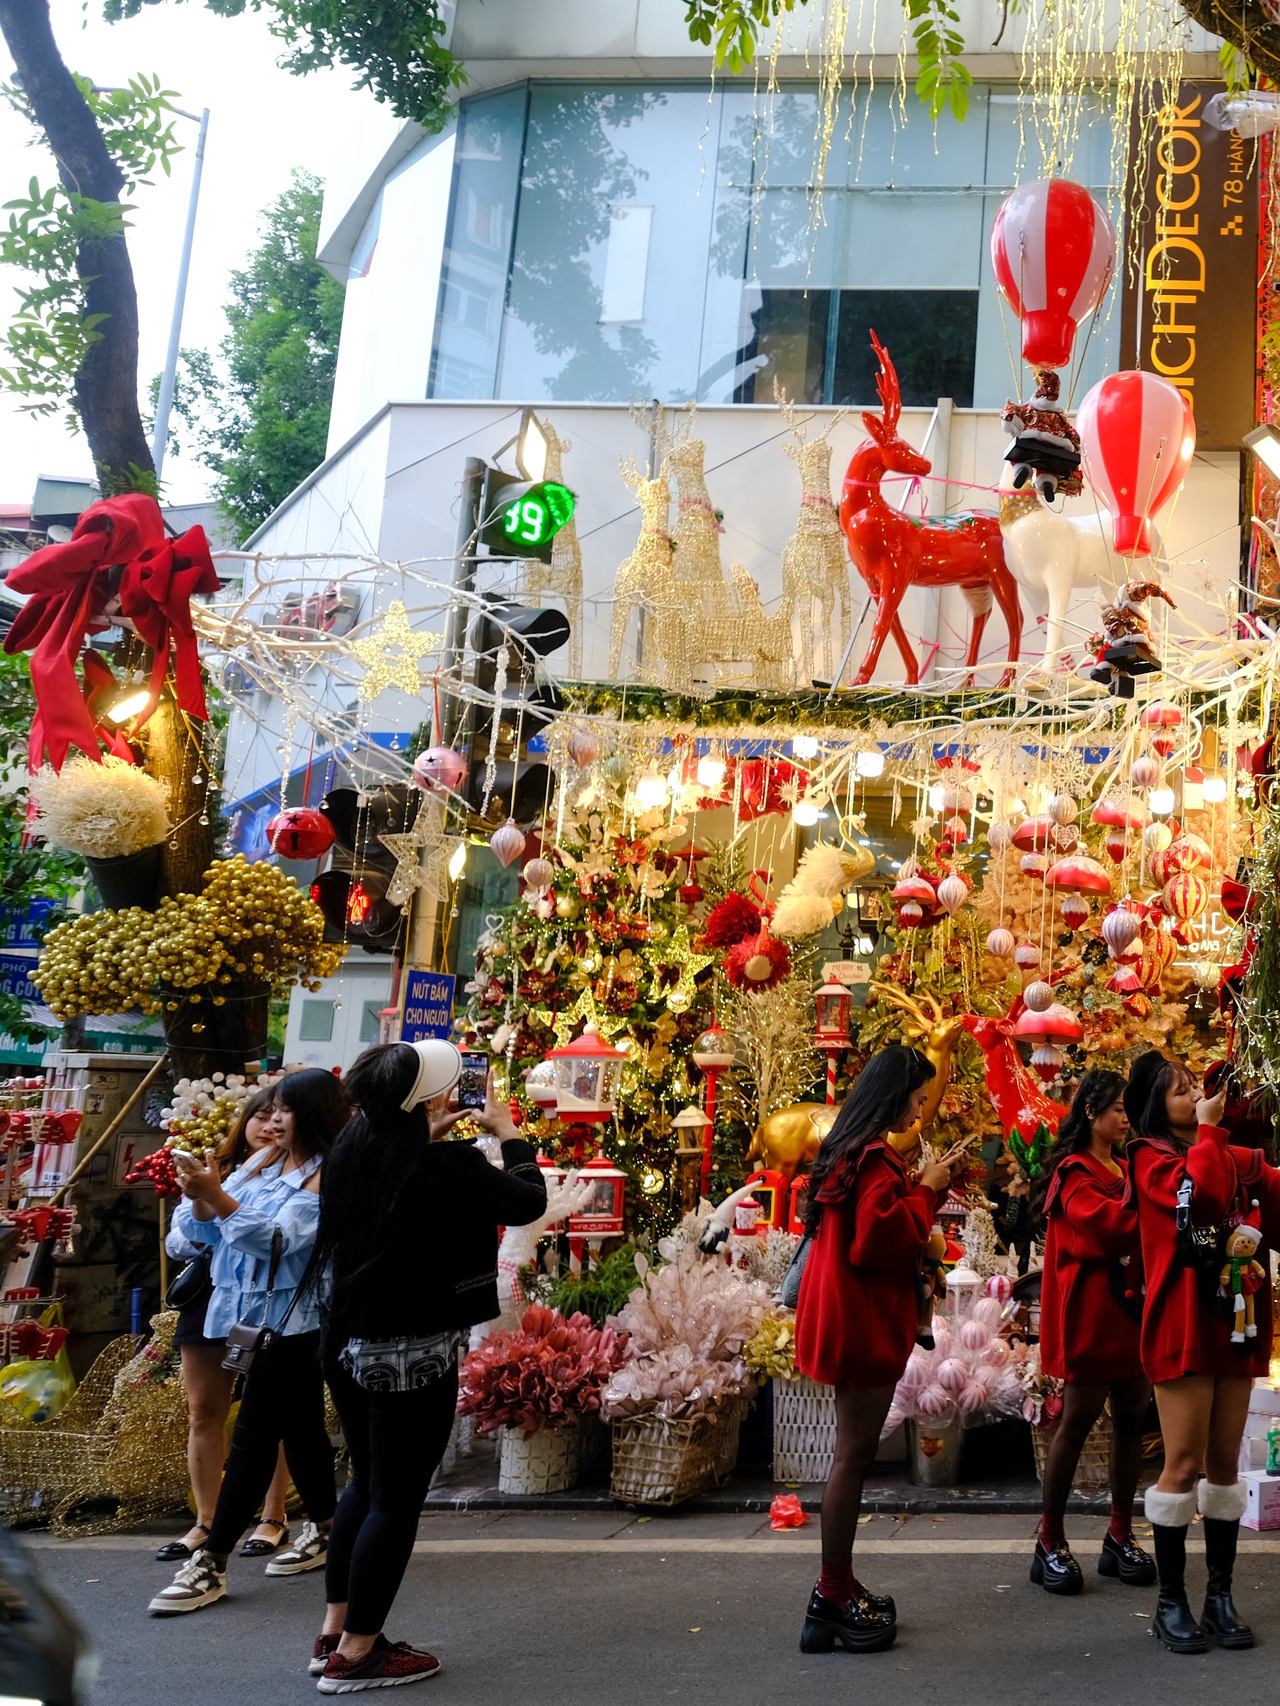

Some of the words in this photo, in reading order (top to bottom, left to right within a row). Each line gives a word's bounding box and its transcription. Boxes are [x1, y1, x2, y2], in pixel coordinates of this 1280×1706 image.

[1223, 179, 1244, 208] 78
[832, 964, 854, 972] MERRY
[412, 978, 430, 999] NÚT
[430, 979, 449, 1002] BẤM
[405, 1007, 423, 1024] CHO
[423, 1006, 448, 1027] NGƯỜI
